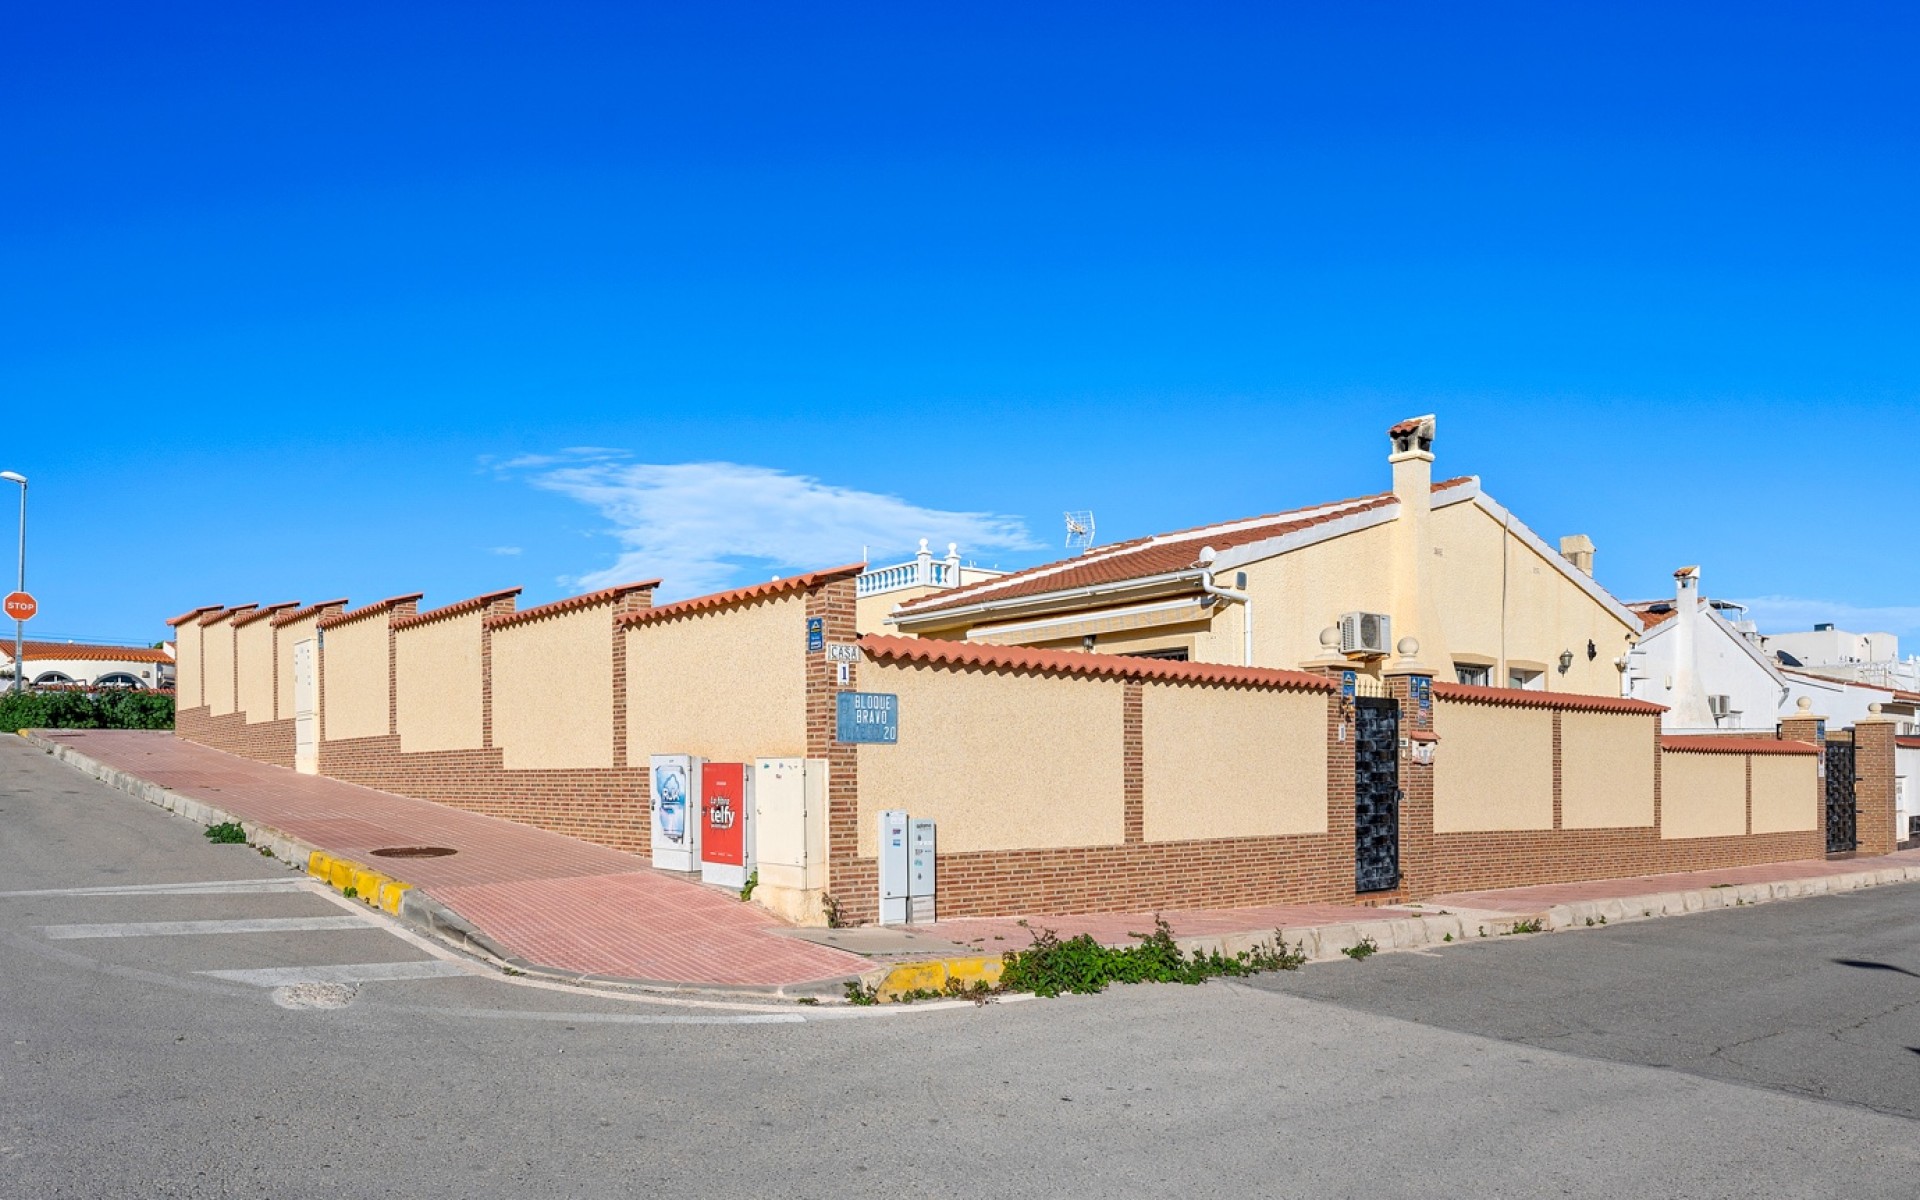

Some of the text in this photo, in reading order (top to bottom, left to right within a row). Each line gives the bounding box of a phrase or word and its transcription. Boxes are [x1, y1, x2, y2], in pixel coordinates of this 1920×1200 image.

[8, 602, 34, 610] STOP
[831, 645, 857, 659] CASA
[855, 695, 891, 710] BLOQUE
[856, 709, 887, 724] BRAVO
[883, 726, 896, 740] 20
[710, 805, 735, 828] telfy
